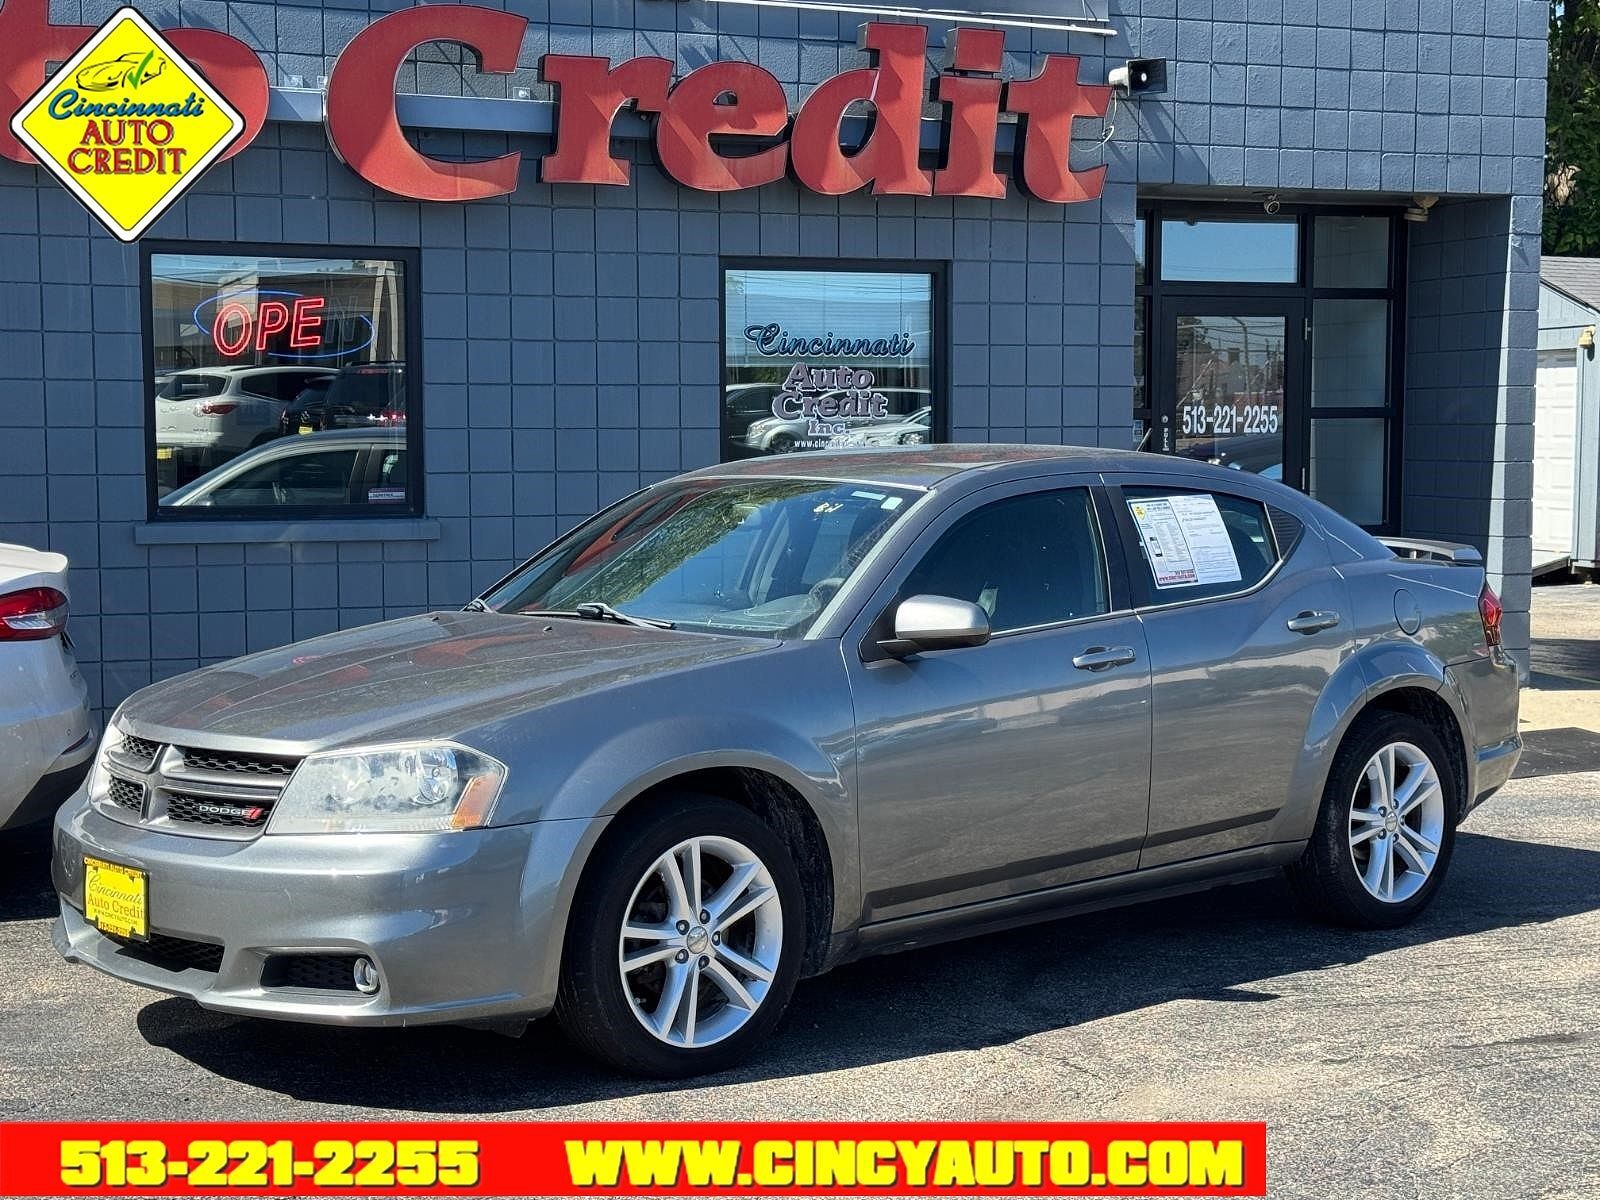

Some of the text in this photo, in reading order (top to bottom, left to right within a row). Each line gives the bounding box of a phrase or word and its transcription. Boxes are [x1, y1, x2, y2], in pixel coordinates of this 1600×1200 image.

[326, 4, 1112, 203] Credit
[744, 322, 915, 357] Cincinnati
[782, 362, 875, 391] Auto
[772, 389, 888, 420] Credit
[808, 420, 850, 436] Inc.
[1182, 405, 1278, 434] 513-221-2255
[199, 805, 250, 817] DODGE
